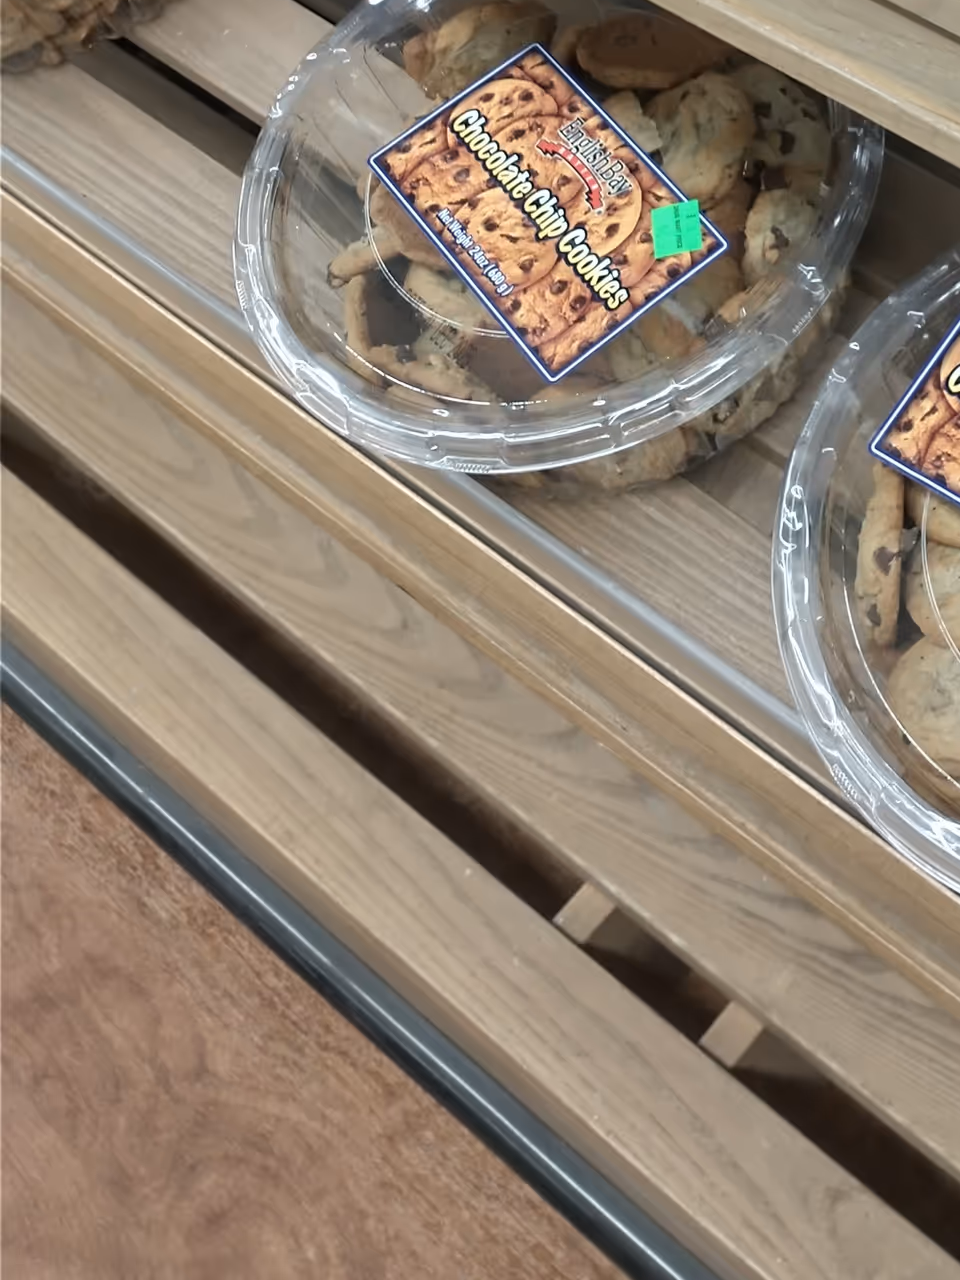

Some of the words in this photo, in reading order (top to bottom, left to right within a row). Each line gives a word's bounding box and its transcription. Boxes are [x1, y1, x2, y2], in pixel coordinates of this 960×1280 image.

[438, 208, 453, 225] Net
[448, 219, 473, 248] Weight
[468, 246, 489, 268] 24oz
[453, 109, 534, 199] Chocolate
[524, 189, 569, 239] Chip
[559, 228, 629, 309] Cookies
